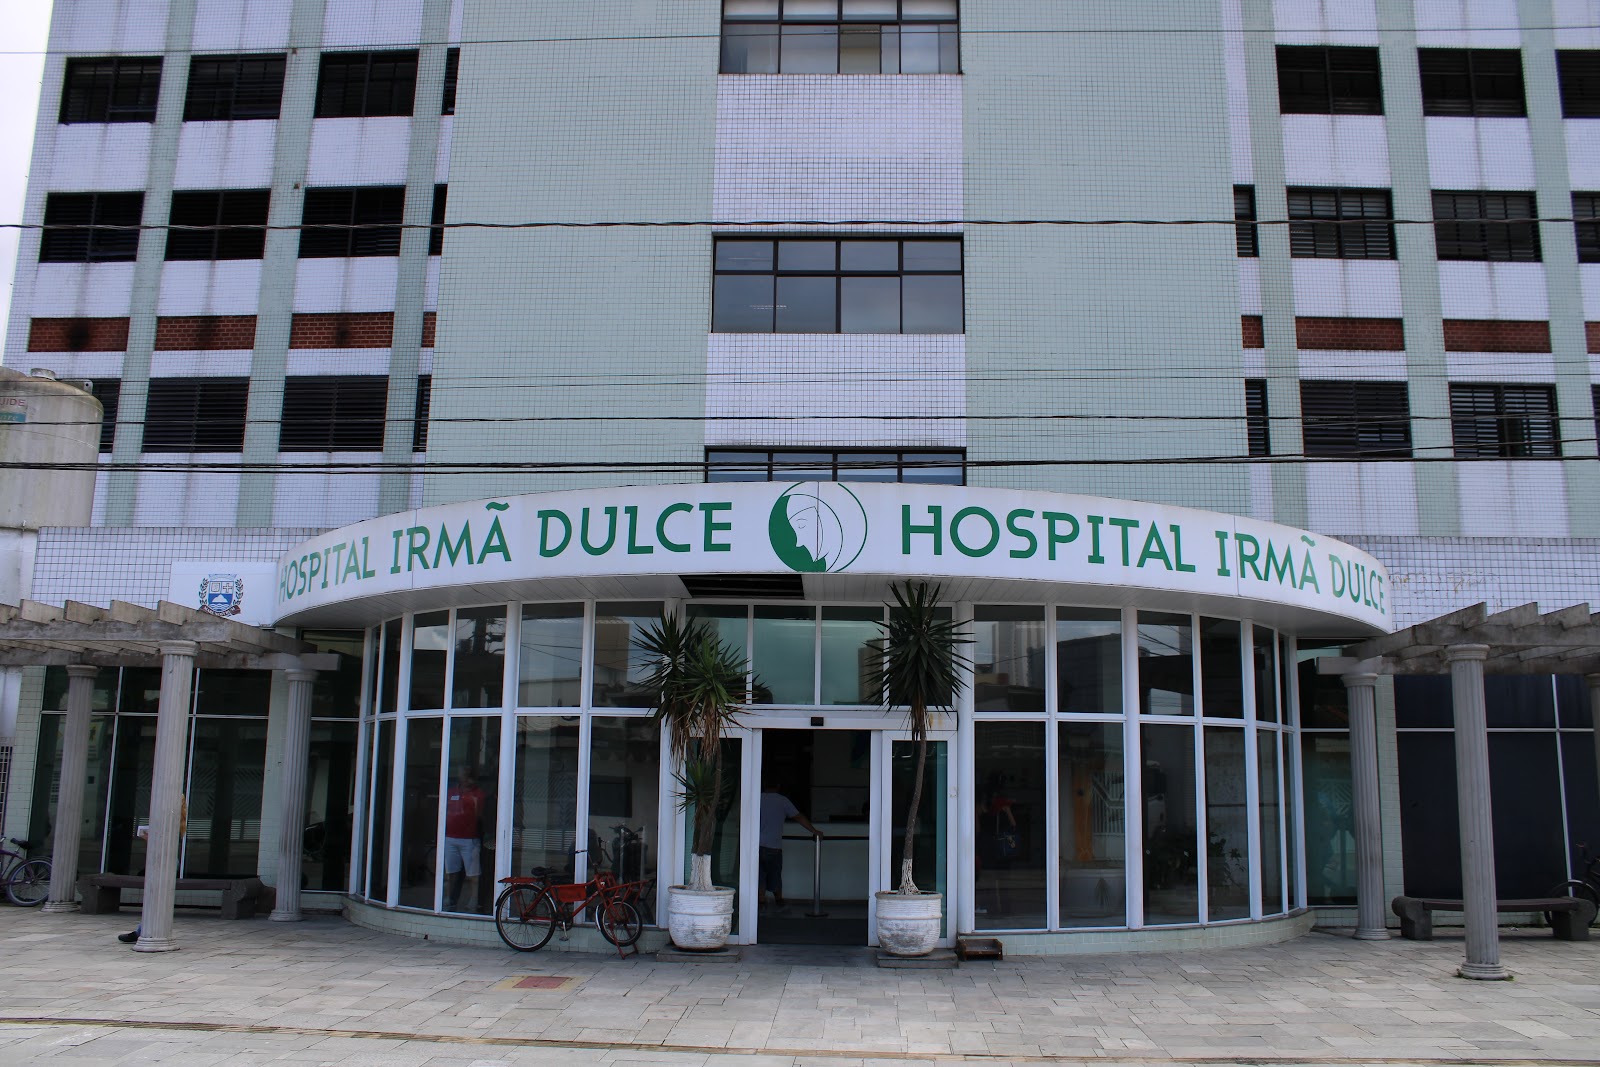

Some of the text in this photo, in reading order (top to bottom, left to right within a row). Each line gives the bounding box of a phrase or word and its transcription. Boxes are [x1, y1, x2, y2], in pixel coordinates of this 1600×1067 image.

[279, 501, 733, 604] HOSPITAL IRMÃ DULCE
[901, 503, 1386, 615] HOSPITAL IRMÃ DULCE
